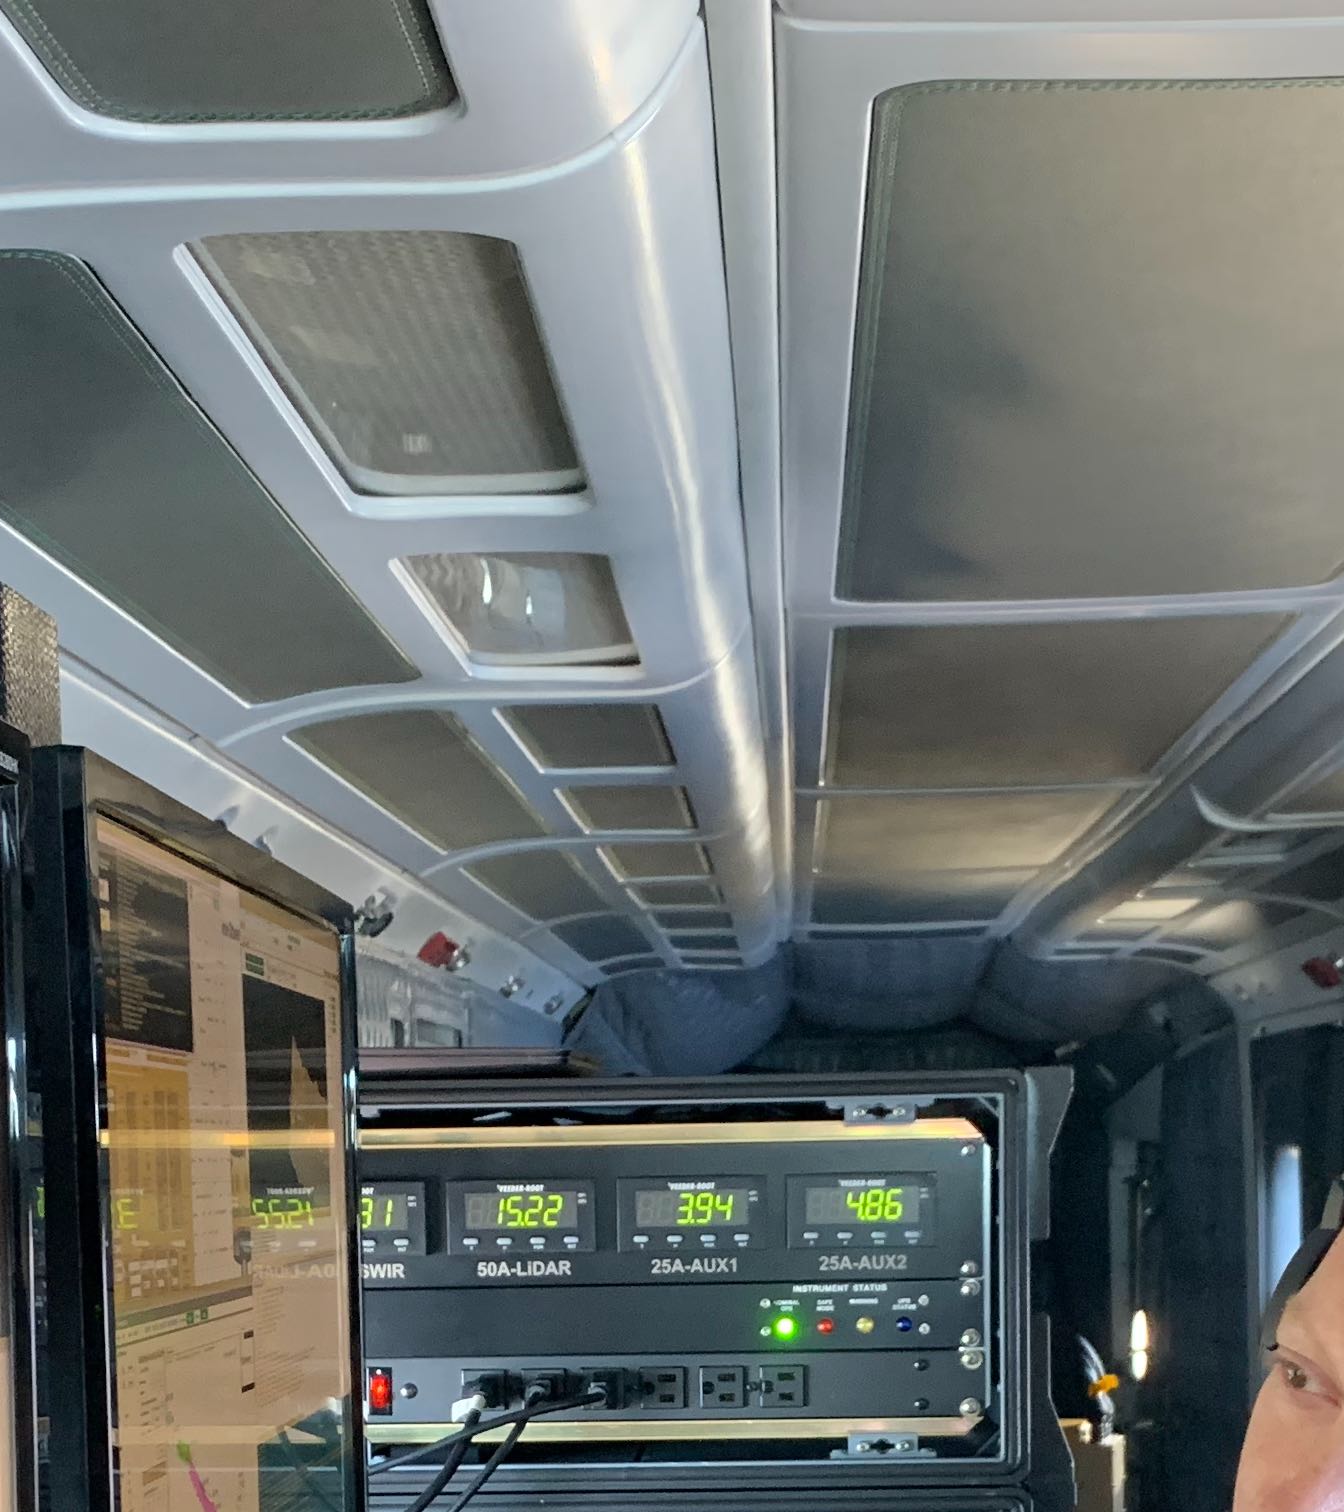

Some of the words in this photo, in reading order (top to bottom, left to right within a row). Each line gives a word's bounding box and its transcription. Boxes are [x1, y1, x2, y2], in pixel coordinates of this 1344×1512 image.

[477, 1260, 571, 1277] 50A-LiDAR
[651, 1258, 738, 1274] 25A-AUX1
[819, 1255, 907, 1271] 25A-AUX2
[792, 1284, 849, 1293] INSTRUMENT
[852, 1283, 888, 1292] STATUS
